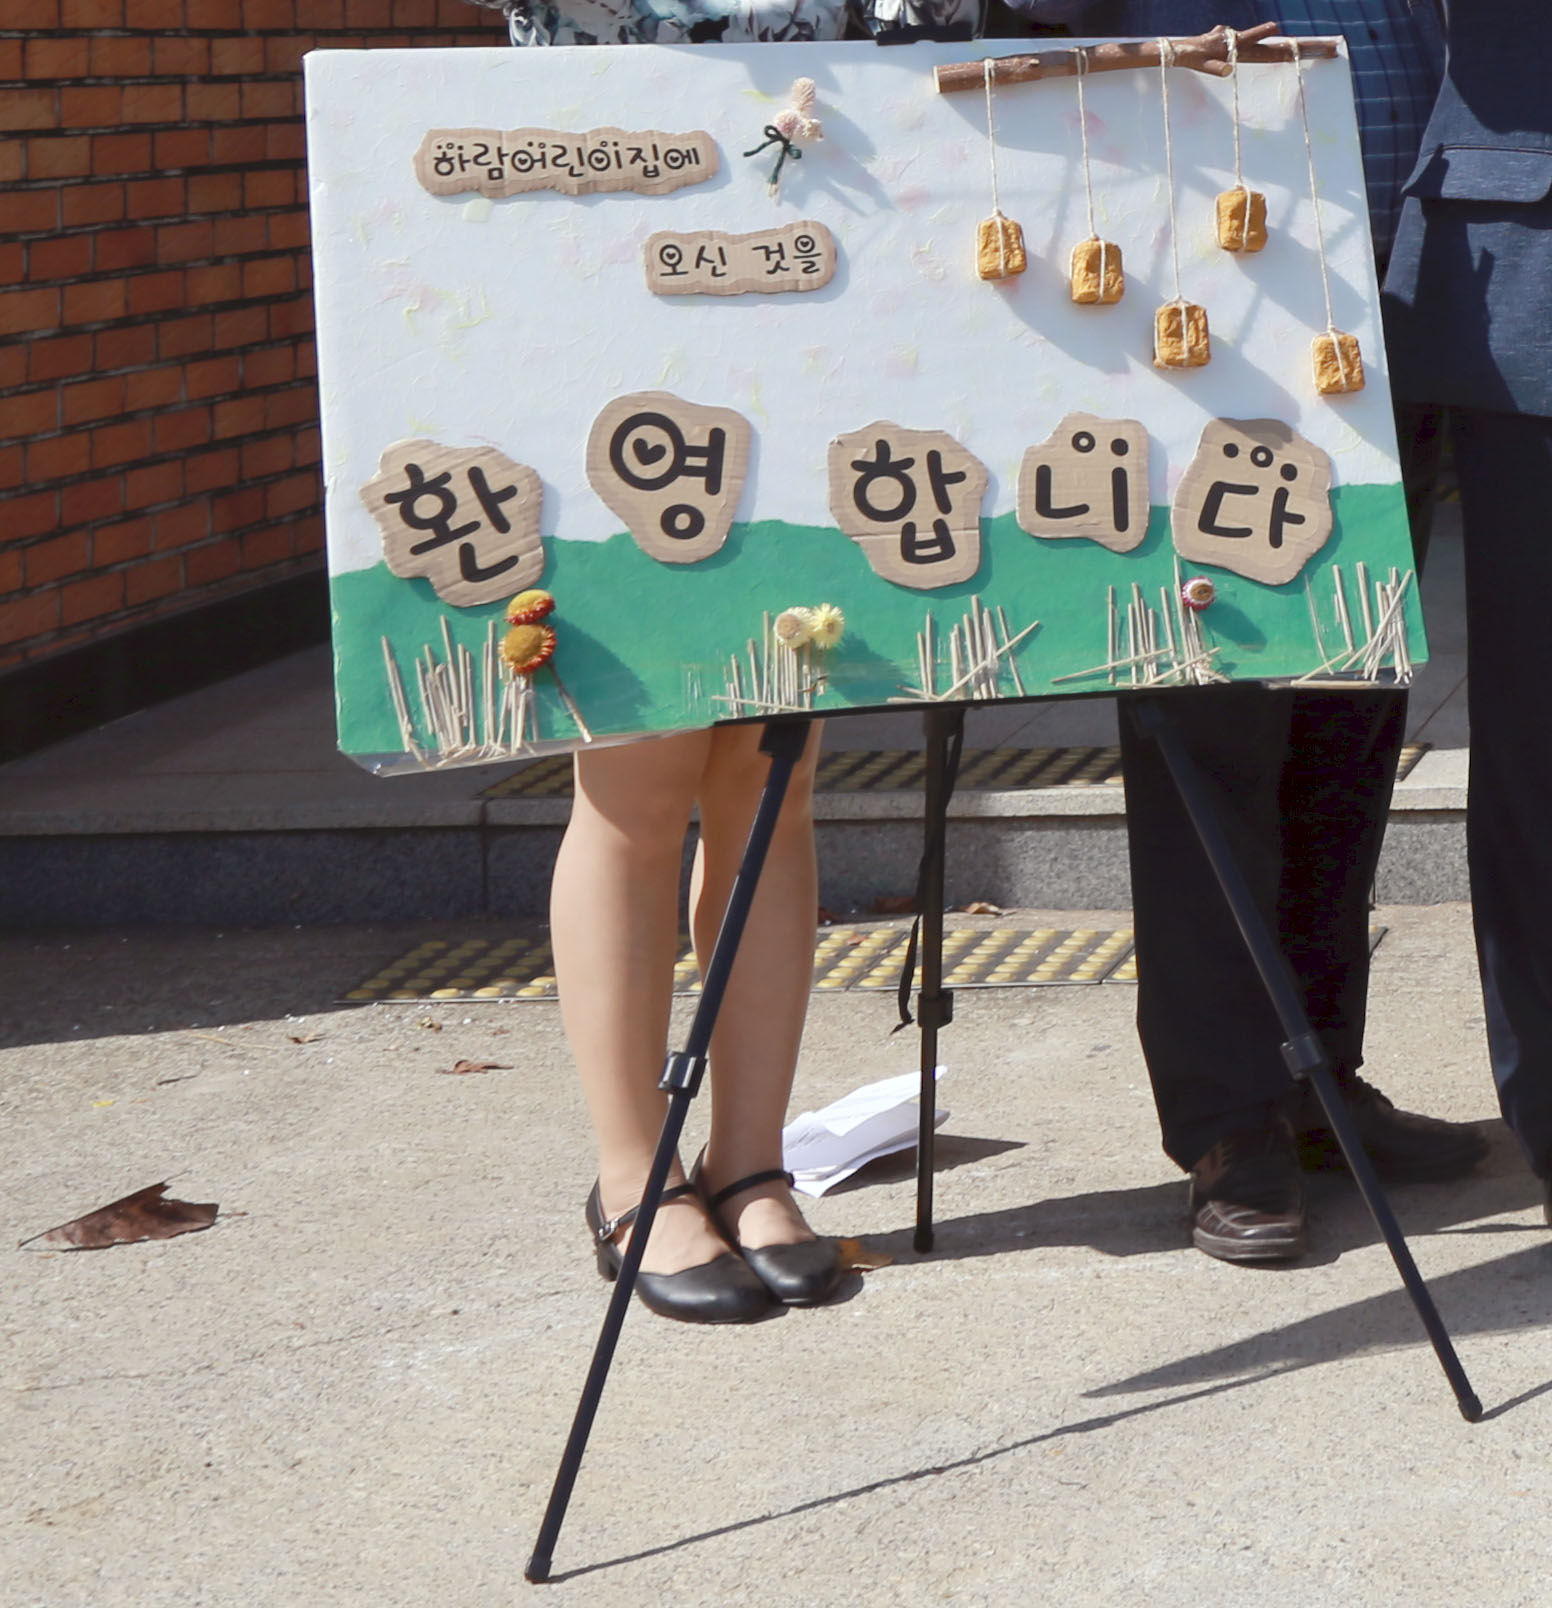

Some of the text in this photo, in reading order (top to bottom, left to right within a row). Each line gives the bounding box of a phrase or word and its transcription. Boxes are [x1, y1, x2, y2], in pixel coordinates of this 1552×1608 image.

[433, 139, 701, 181] 하람어린이집에
[659, 234, 822, 277] 오신 것을
